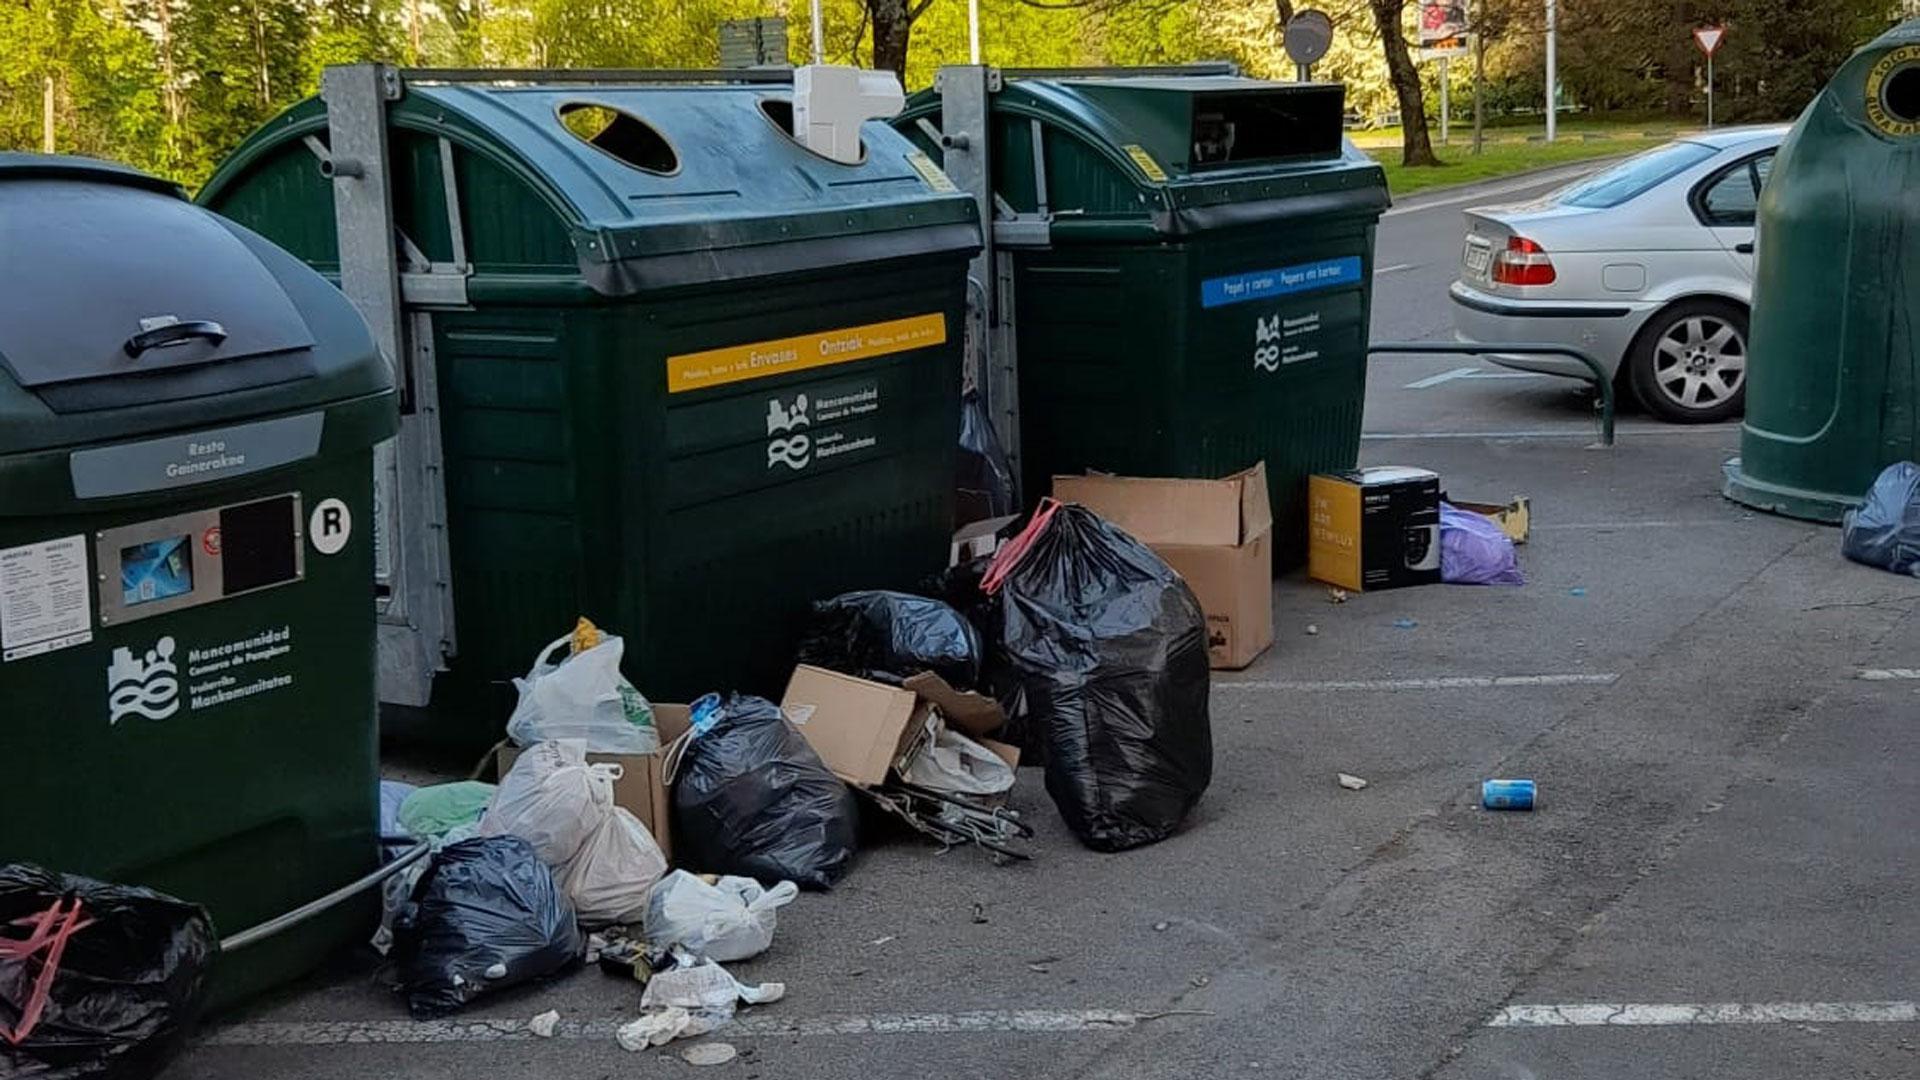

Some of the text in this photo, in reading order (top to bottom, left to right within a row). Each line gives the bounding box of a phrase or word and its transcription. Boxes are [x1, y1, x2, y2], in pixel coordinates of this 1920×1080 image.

[1874, 50, 1907, 76] SOLO
[750, 349, 798, 369] Envases
[819, 334, 863, 356] Ontziak
[189, 441, 226, 456] Resto
[322, 506, 342, 537] R
[188, 625, 290, 662] Mancomunidad
[188, 645, 291, 677] Comarca de Pamplona
[190, 674, 292, 709] Mankomunitatea
